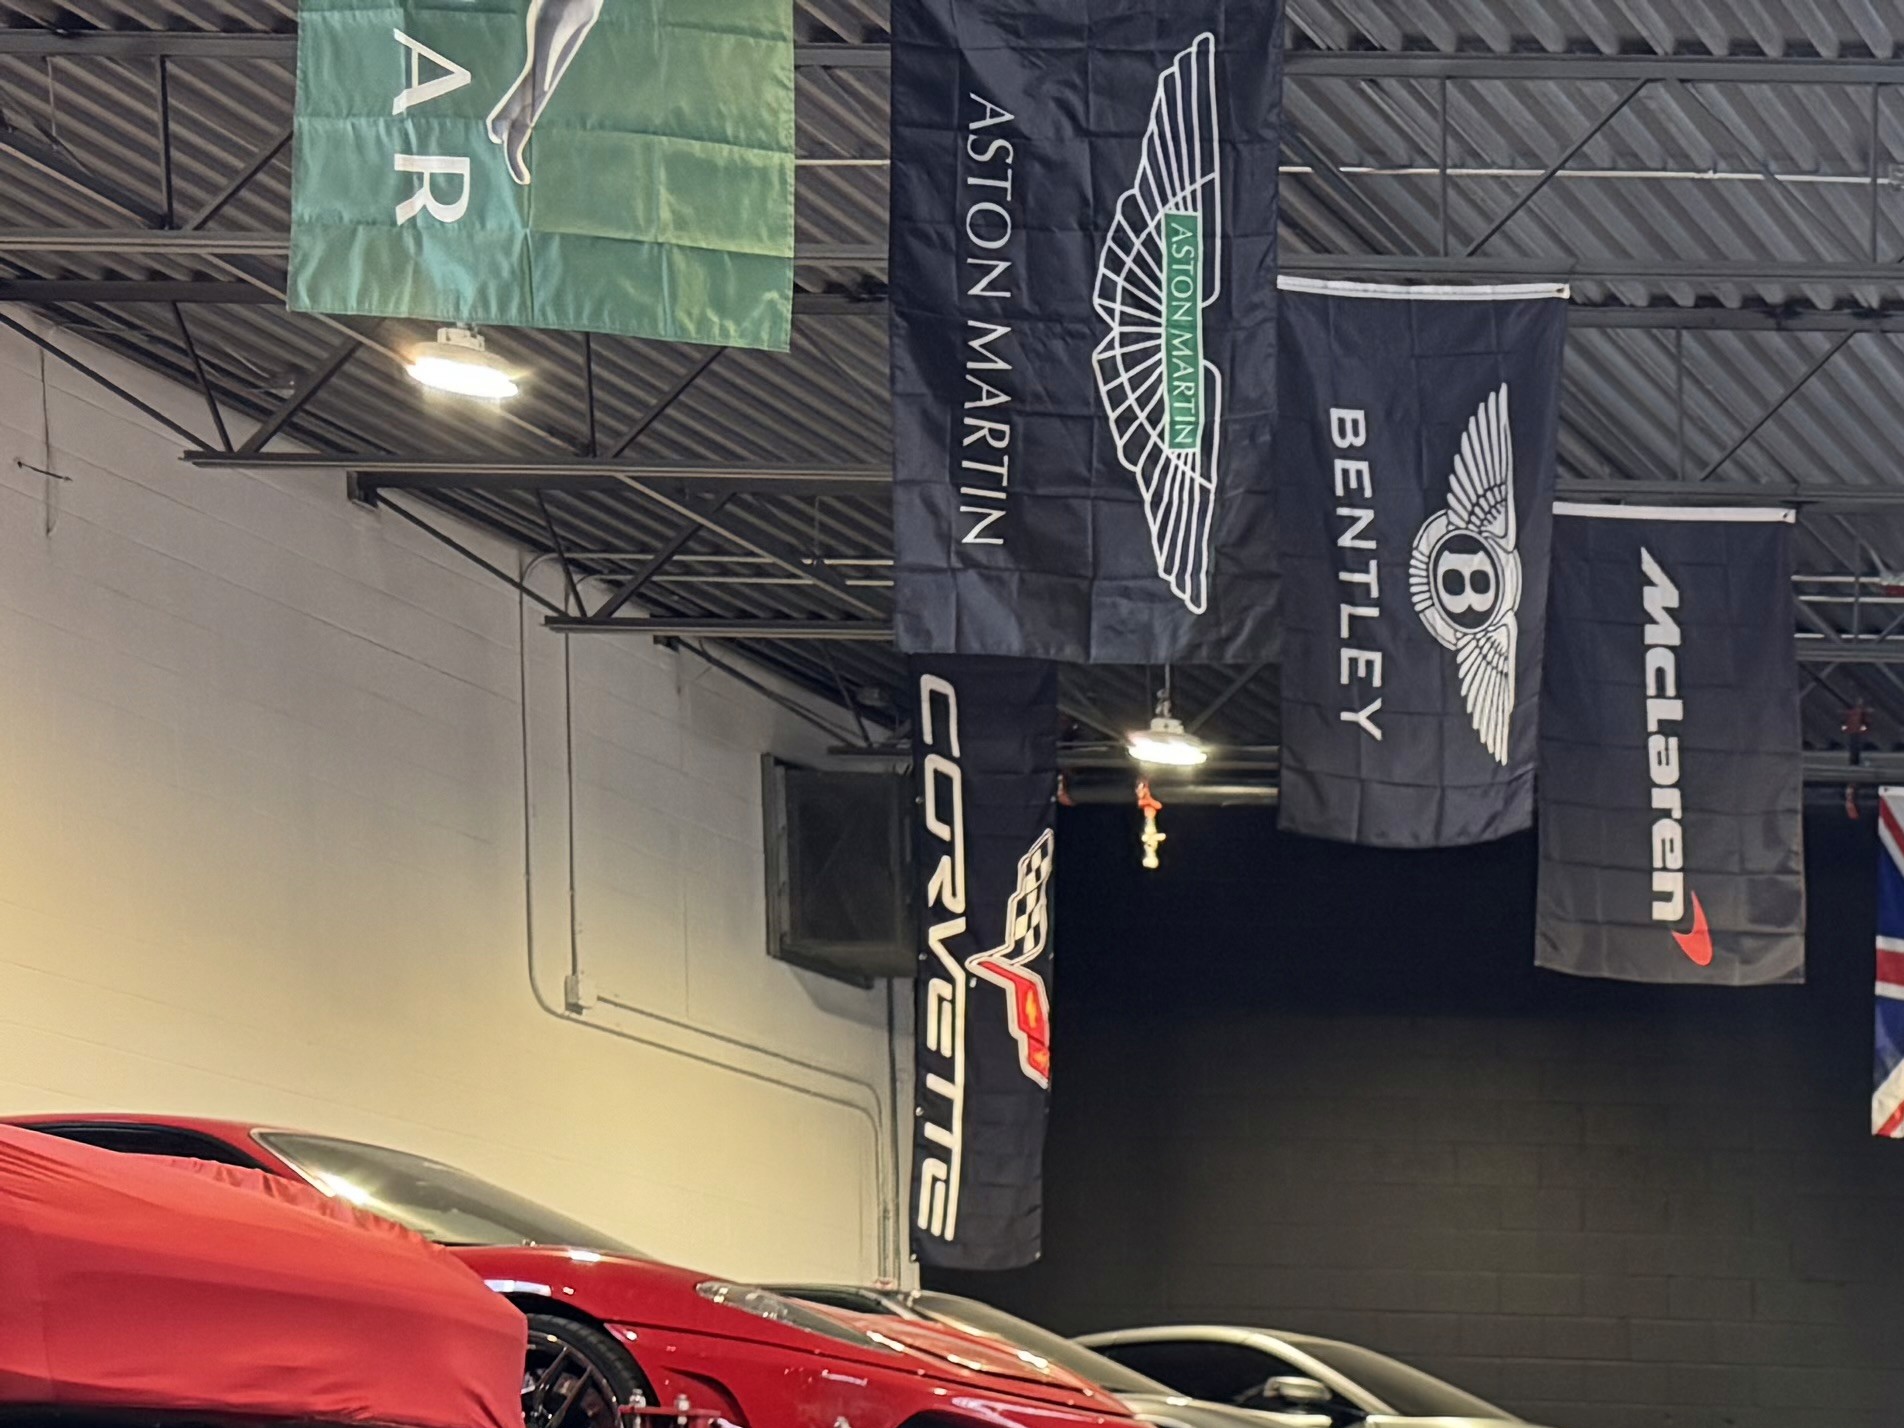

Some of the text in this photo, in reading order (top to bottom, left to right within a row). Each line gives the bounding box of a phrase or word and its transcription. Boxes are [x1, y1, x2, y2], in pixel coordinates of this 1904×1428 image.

[959, 92, 1015, 546] ASTON MARTIN
[1170, 221, 1197, 445] ASTON MARTIN
[1329, 407, 1382, 742] BENTLEY
[1640, 546, 1685, 922] McLaren
[916, 673, 967, 1242] CORVETTE
